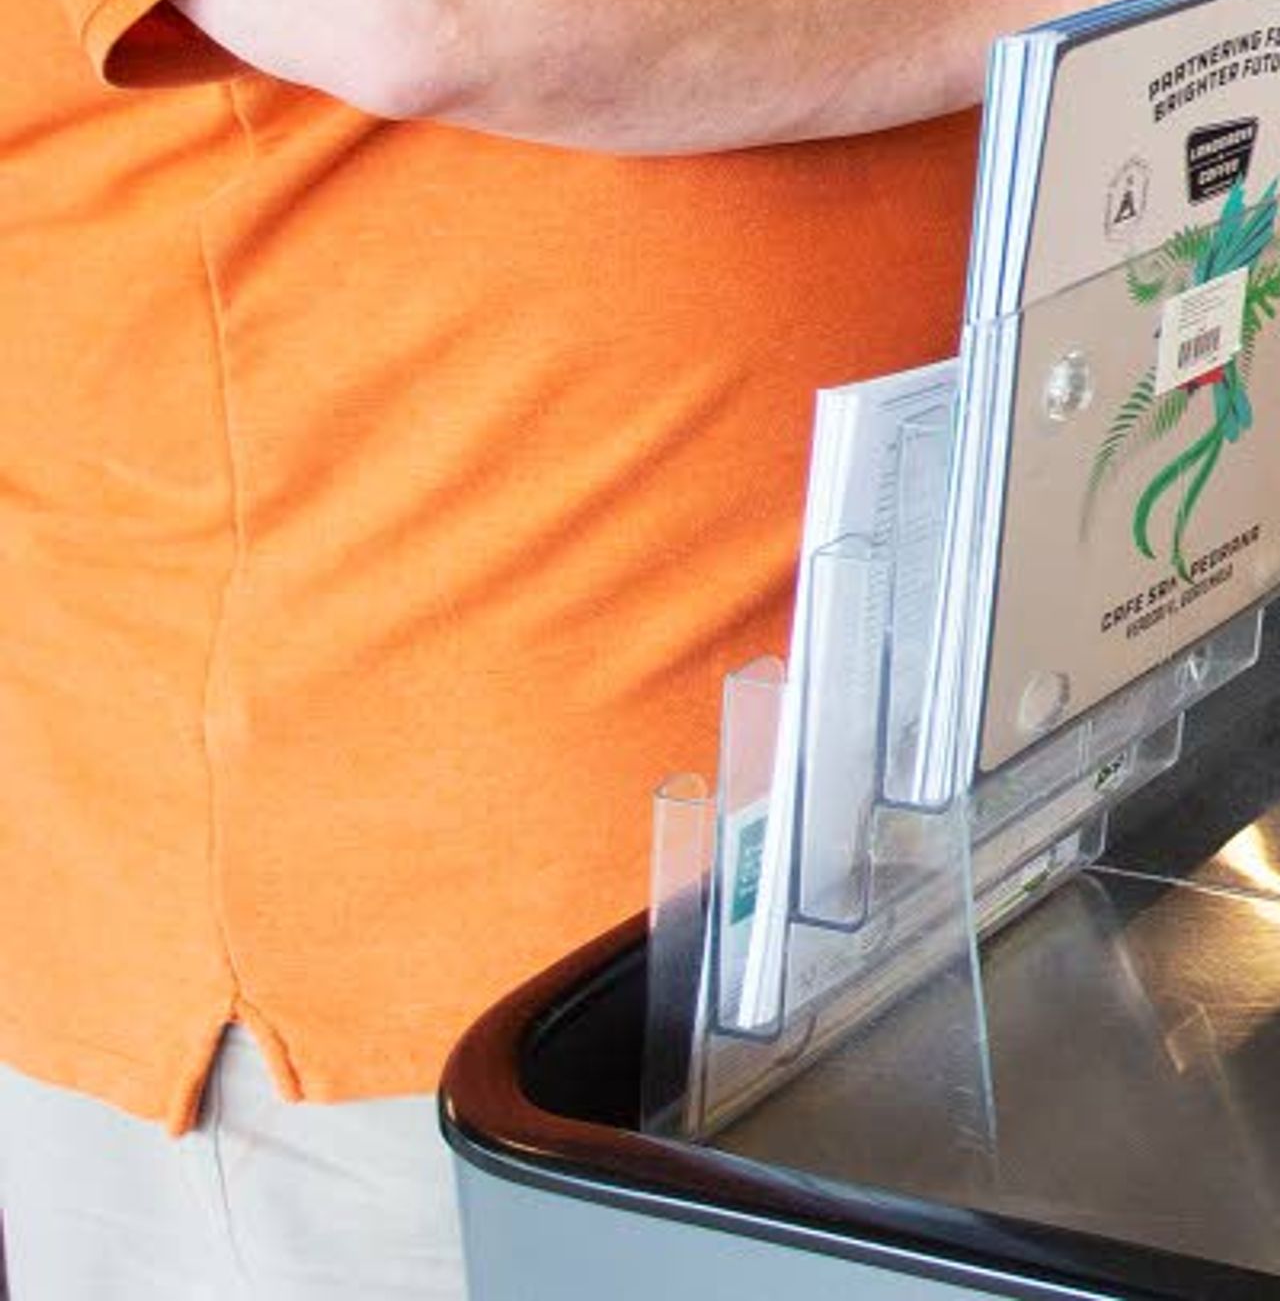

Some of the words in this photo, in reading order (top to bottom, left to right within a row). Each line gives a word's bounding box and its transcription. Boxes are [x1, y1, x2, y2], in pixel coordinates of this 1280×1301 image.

[1148, 30, 1262, 102] PARTNERING
[1154, 61, 1240, 124] BRIGHTER
[1101, 593, 1145, 634] CAFE
